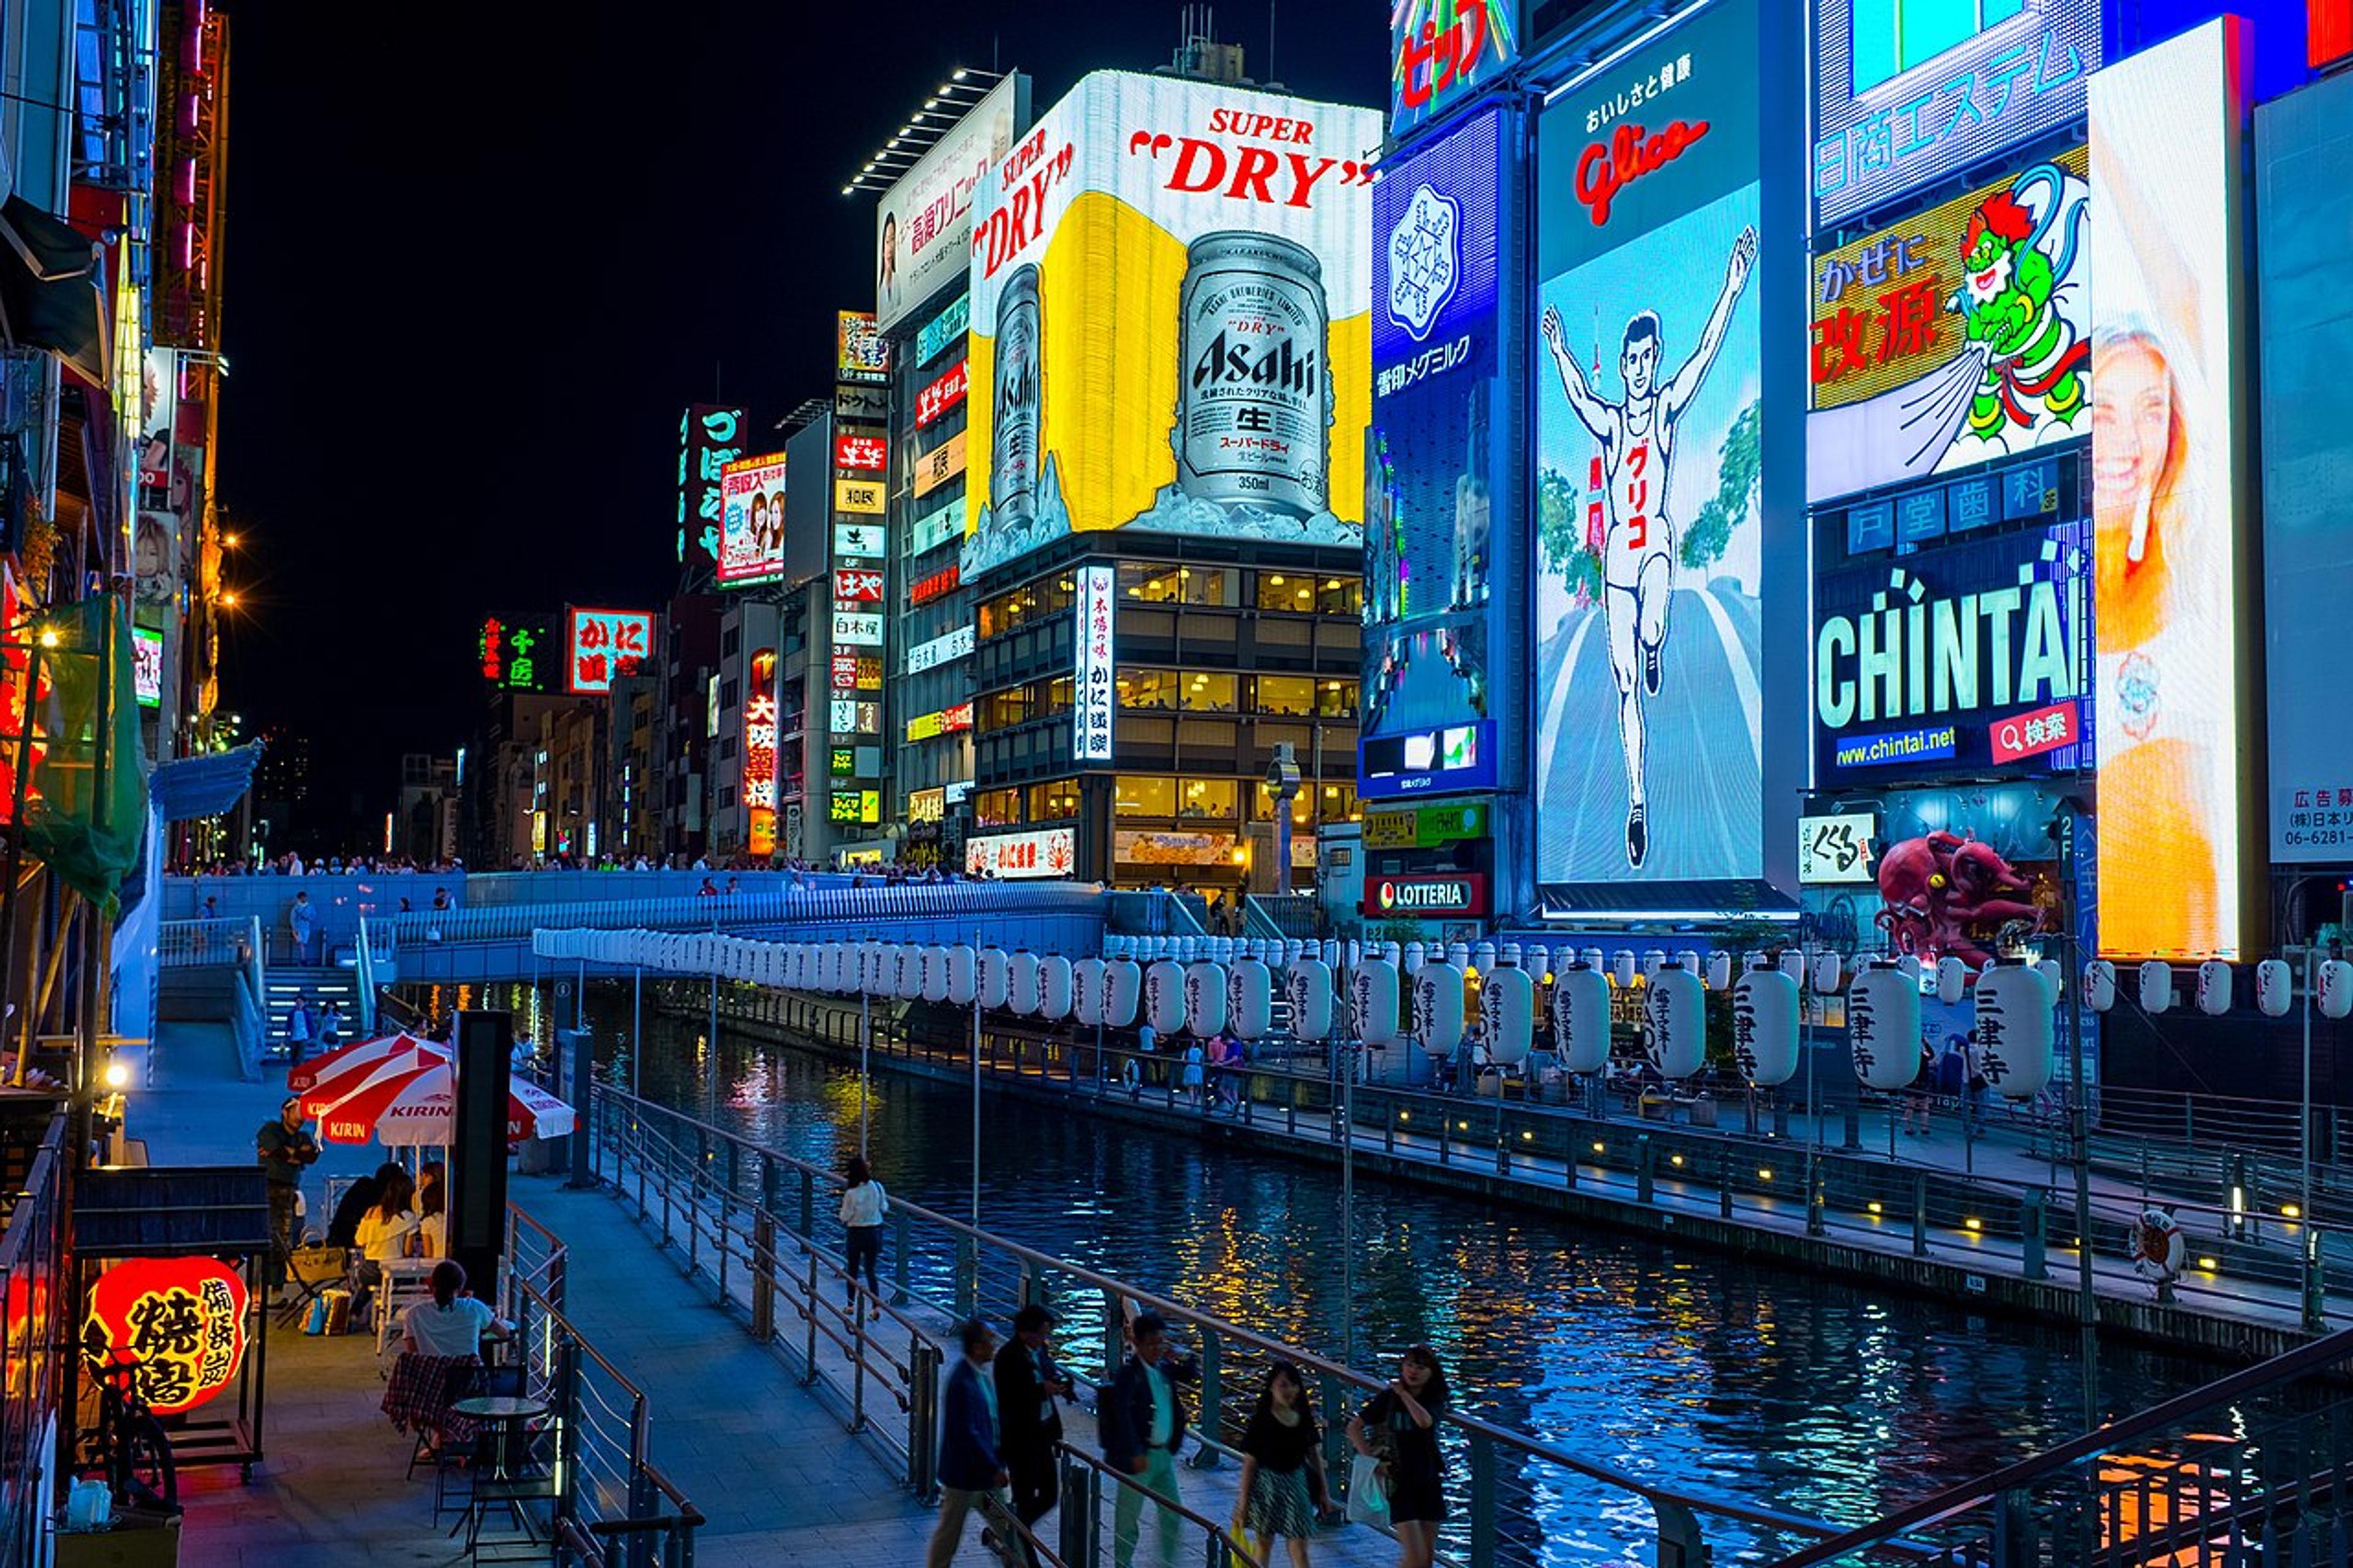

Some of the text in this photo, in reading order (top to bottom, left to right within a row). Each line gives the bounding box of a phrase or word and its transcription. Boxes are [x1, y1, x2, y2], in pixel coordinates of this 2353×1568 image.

[1586, 53, 1691, 134] おいしさと健康
[1814, 29, 2082, 197] 日商エステム
[1209, 108, 1314, 145] SUPER
[1001, 128, 1045, 191] SUPER
[1575, 120, 1710, 226] Glico
[1820, 233, 1927, 303] かぜに
[1809, 275, 1938, 384] 改源
[1193, 328, 1314, 398] Asahi
[1376, 334, 1471, 398] 雪印メグミルク
[1236, 406, 1273, 433] 生
[1219, 437, 1290, 454] スーパードライ
[1626, 437, 1650, 550] グリコ
[578, 617, 643, 651] かに
[836, 617, 878, 635] 白木屋
[1837, 726, 1955, 766] ww.chintai.net
[2024, 713, 2068, 747] 検索
[2285, 830, 2353, 845] 06-6281-
[1396, 884, 1463, 906] LOTTERIA
[1850, 987, 1876, 1079] 三津寺
[1976, 988, 2010, 1085] 三津寺
[330, 1122, 366, 1138] KIRIN
[390, 1105, 452, 1118] KIRIN
